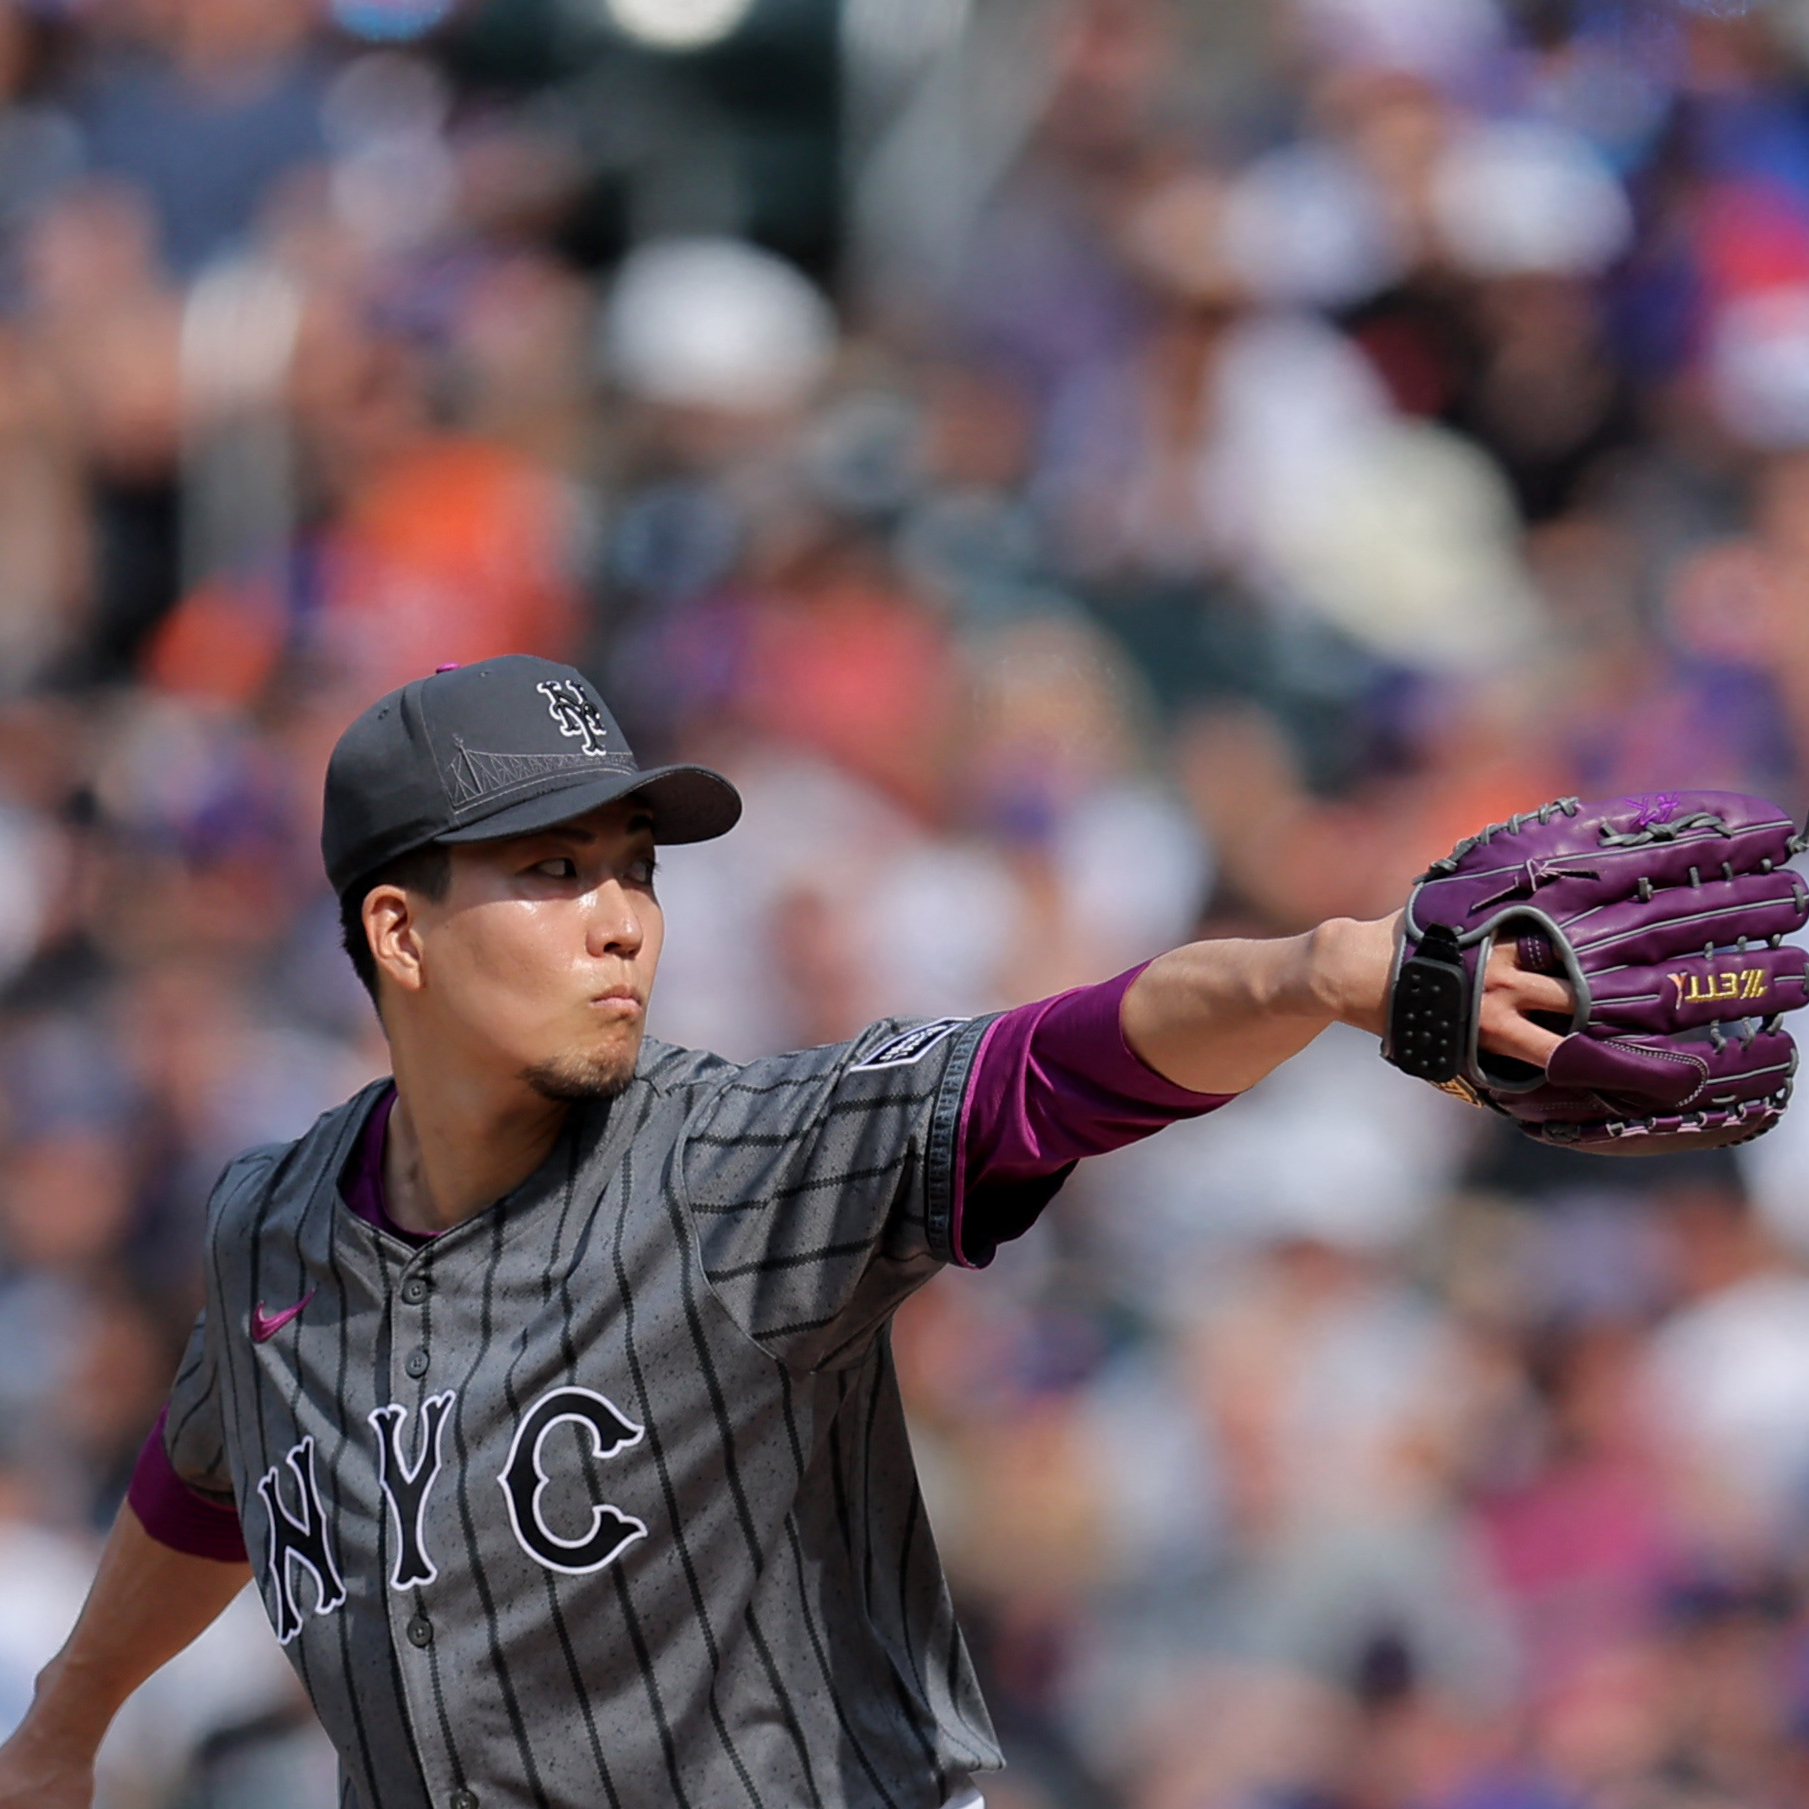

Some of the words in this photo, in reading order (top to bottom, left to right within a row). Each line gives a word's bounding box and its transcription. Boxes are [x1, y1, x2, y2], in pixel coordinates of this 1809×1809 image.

[536, 680, 607, 757] NY
[1684, 969, 1768, 1003] ZETT
[257, 1386, 648, 1644] NYC
